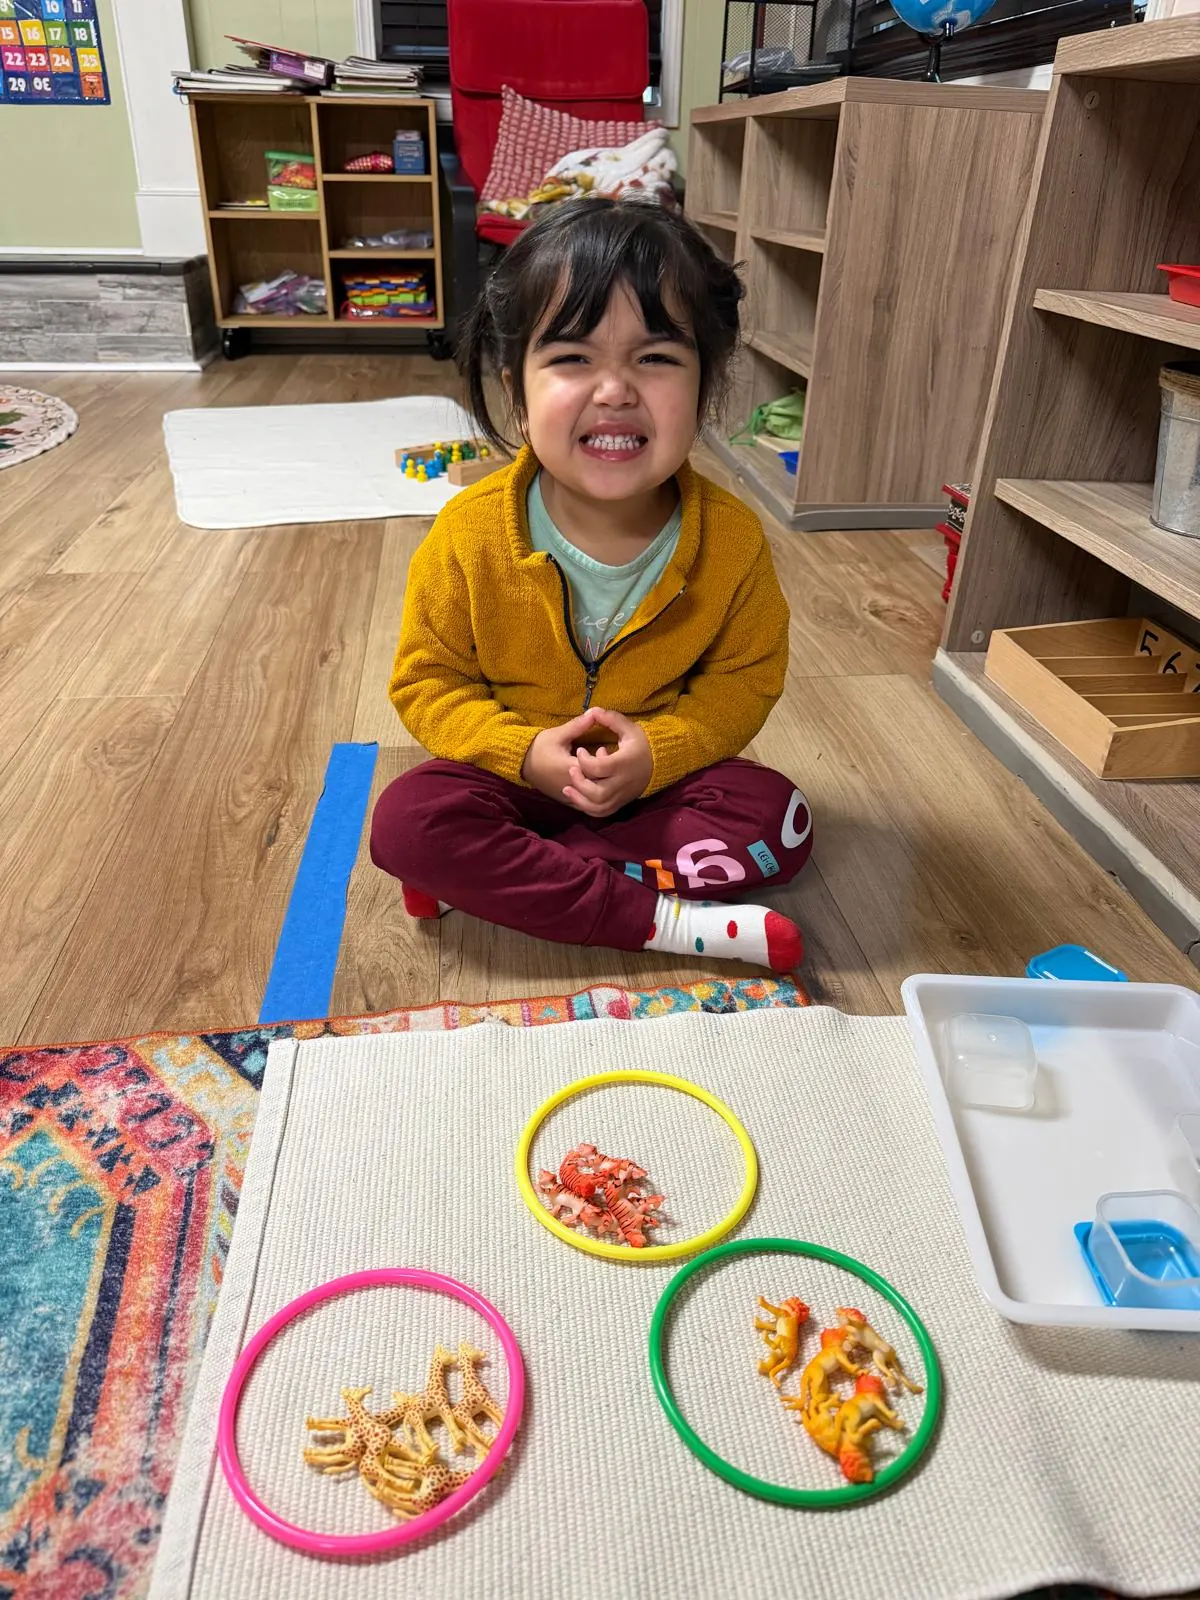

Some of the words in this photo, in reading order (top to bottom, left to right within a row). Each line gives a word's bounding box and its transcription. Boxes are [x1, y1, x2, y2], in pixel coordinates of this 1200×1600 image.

[45, 0, 60, 13] 10
[0, 27, 14, 40] 15
[25, 27, 40, 40] 16
[48, 28, 61, 40] 17
[74, 28, 88, 41] 18
[4, 52, 25, 66] 22
[27, 53, 47, 66] 23
[52, 54, 71, 67] 24
[80, 54, 98, 67] 25
[8, 77, 26, 92] 29
[1140, 629, 1159, 656] 5
[1162, 651, 1181, 674] 6
